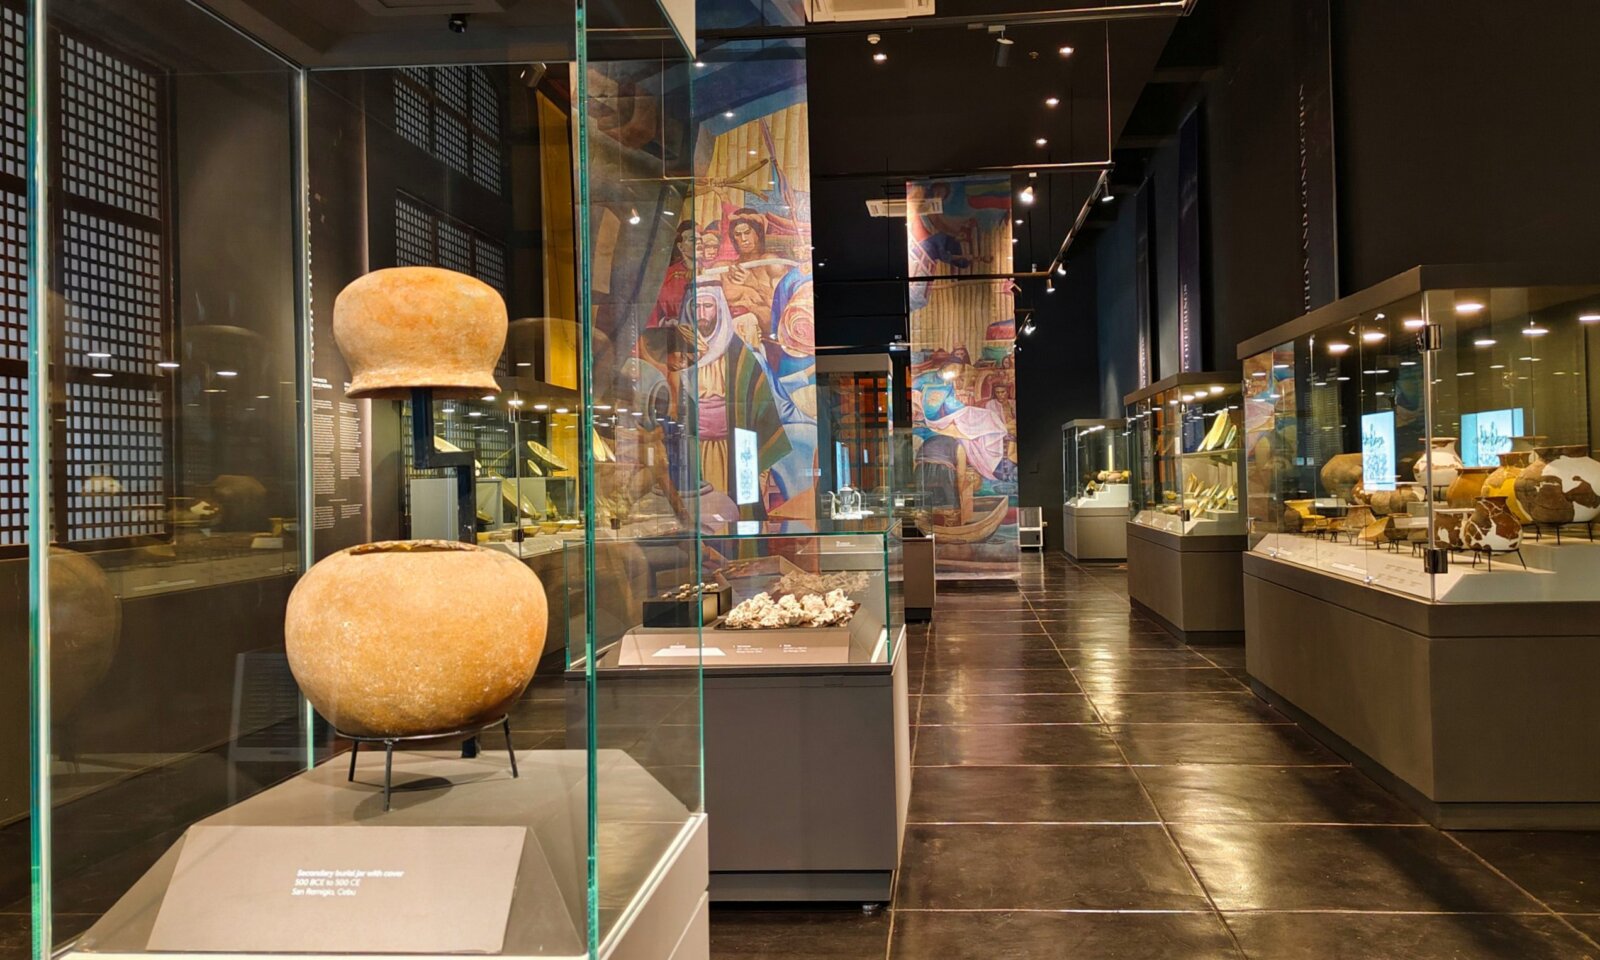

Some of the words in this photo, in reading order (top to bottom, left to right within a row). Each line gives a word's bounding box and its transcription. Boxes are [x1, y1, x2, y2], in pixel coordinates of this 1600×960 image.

[1302, 213, 1310, 252] AND
[297, 869, 334, 879] Secondary
[335, 868, 355, 878] burial
[355, 868, 366, 879] jar
[366, 868, 383, 877] with
[383, 870, 405, 878] cover
[309, 878, 325, 886] BCE
[350, 878, 361, 886] CE
[291, 887, 305, 896] San
[305, 887, 336, 897] Remigio,
[336, 887, 357, 896] Cebu
